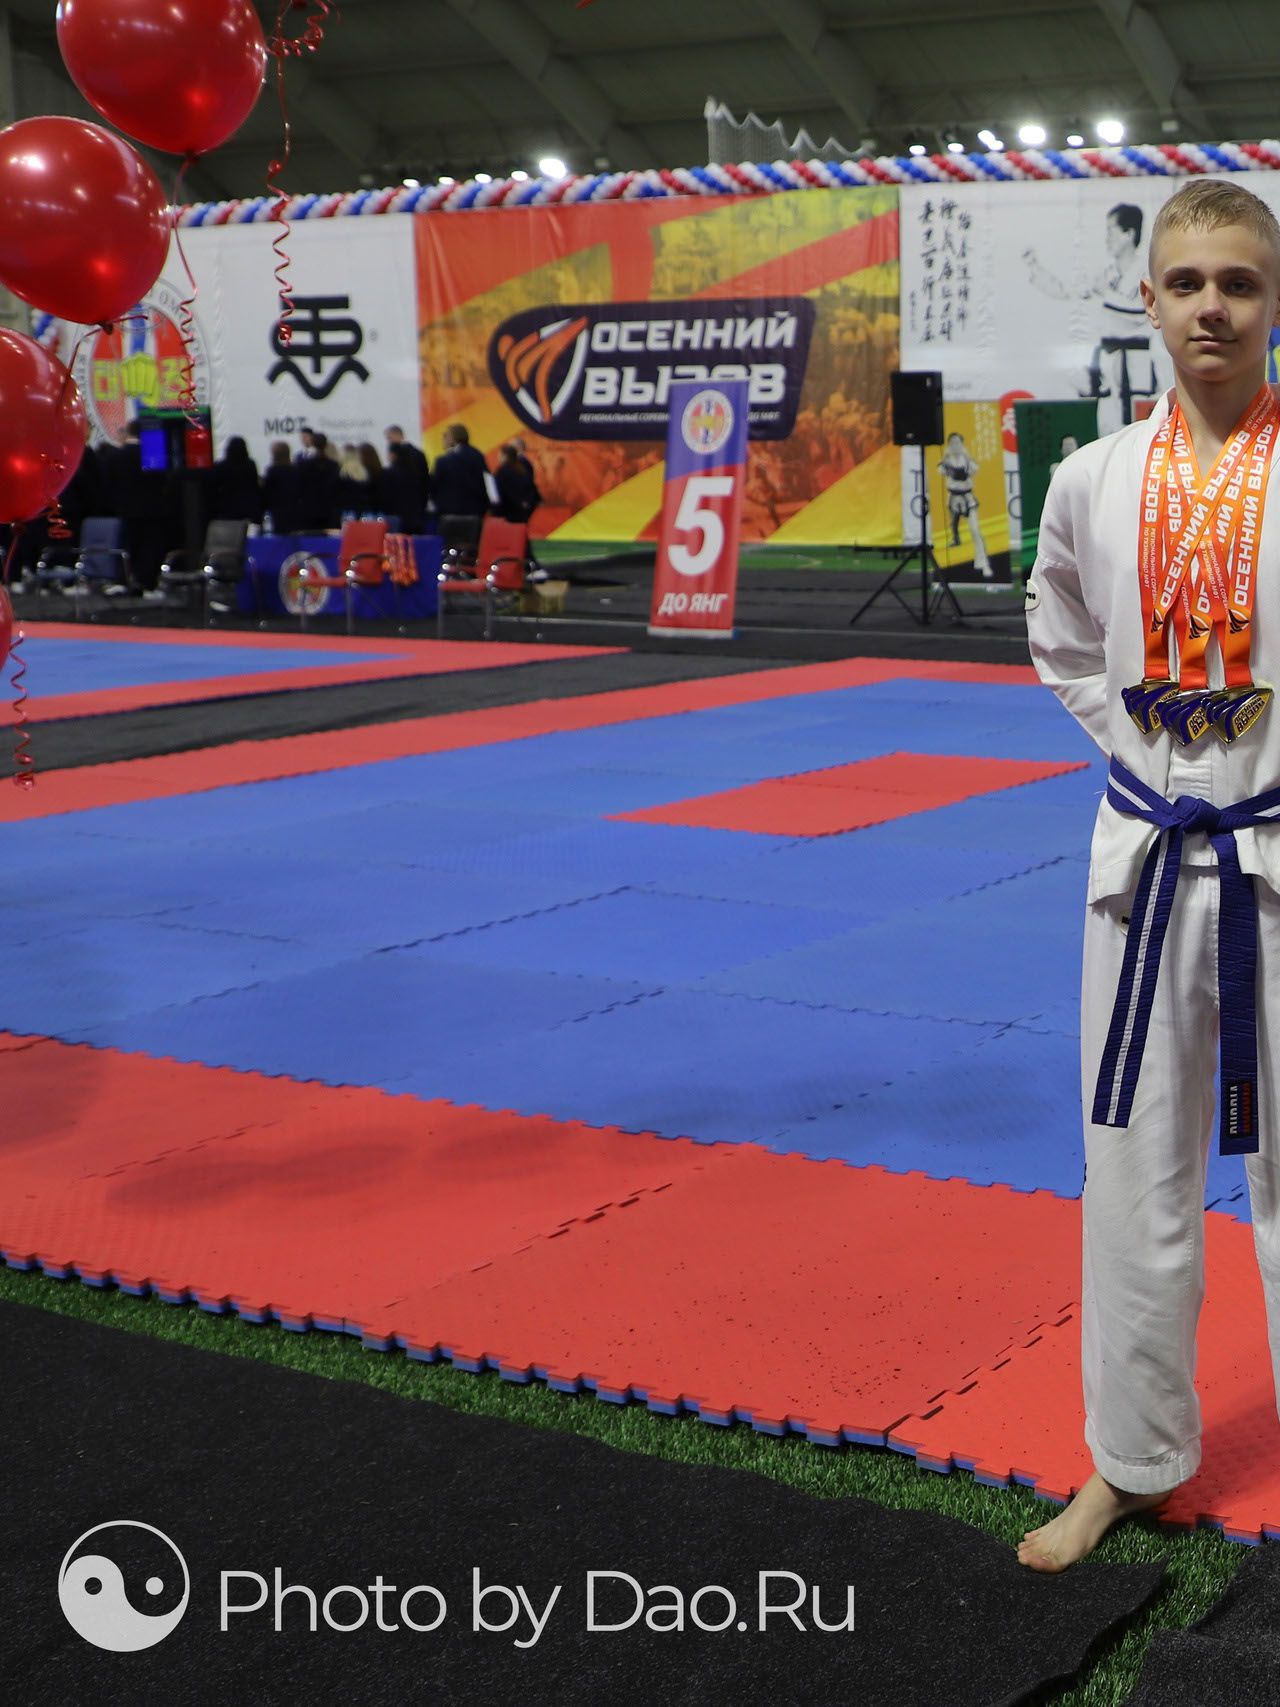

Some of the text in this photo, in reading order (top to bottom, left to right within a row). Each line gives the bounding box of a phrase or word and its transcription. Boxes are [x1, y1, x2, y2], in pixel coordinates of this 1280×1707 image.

[591, 311, 797, 352] ОСЕННИЙ
[1144, 447, 1165, 523] ВЫЗОВ
[1160, 430, 1251, 608] ОСЕННИЙ ВЫЗОВ
[1166, 462, 1182, 533] ЫЗОВ
[668, 476, 734, 576] 5
[1234, 495, 1259, 607] ОСЕННИЙ
[658, 592, 728, 615] ДО ЯНГ
